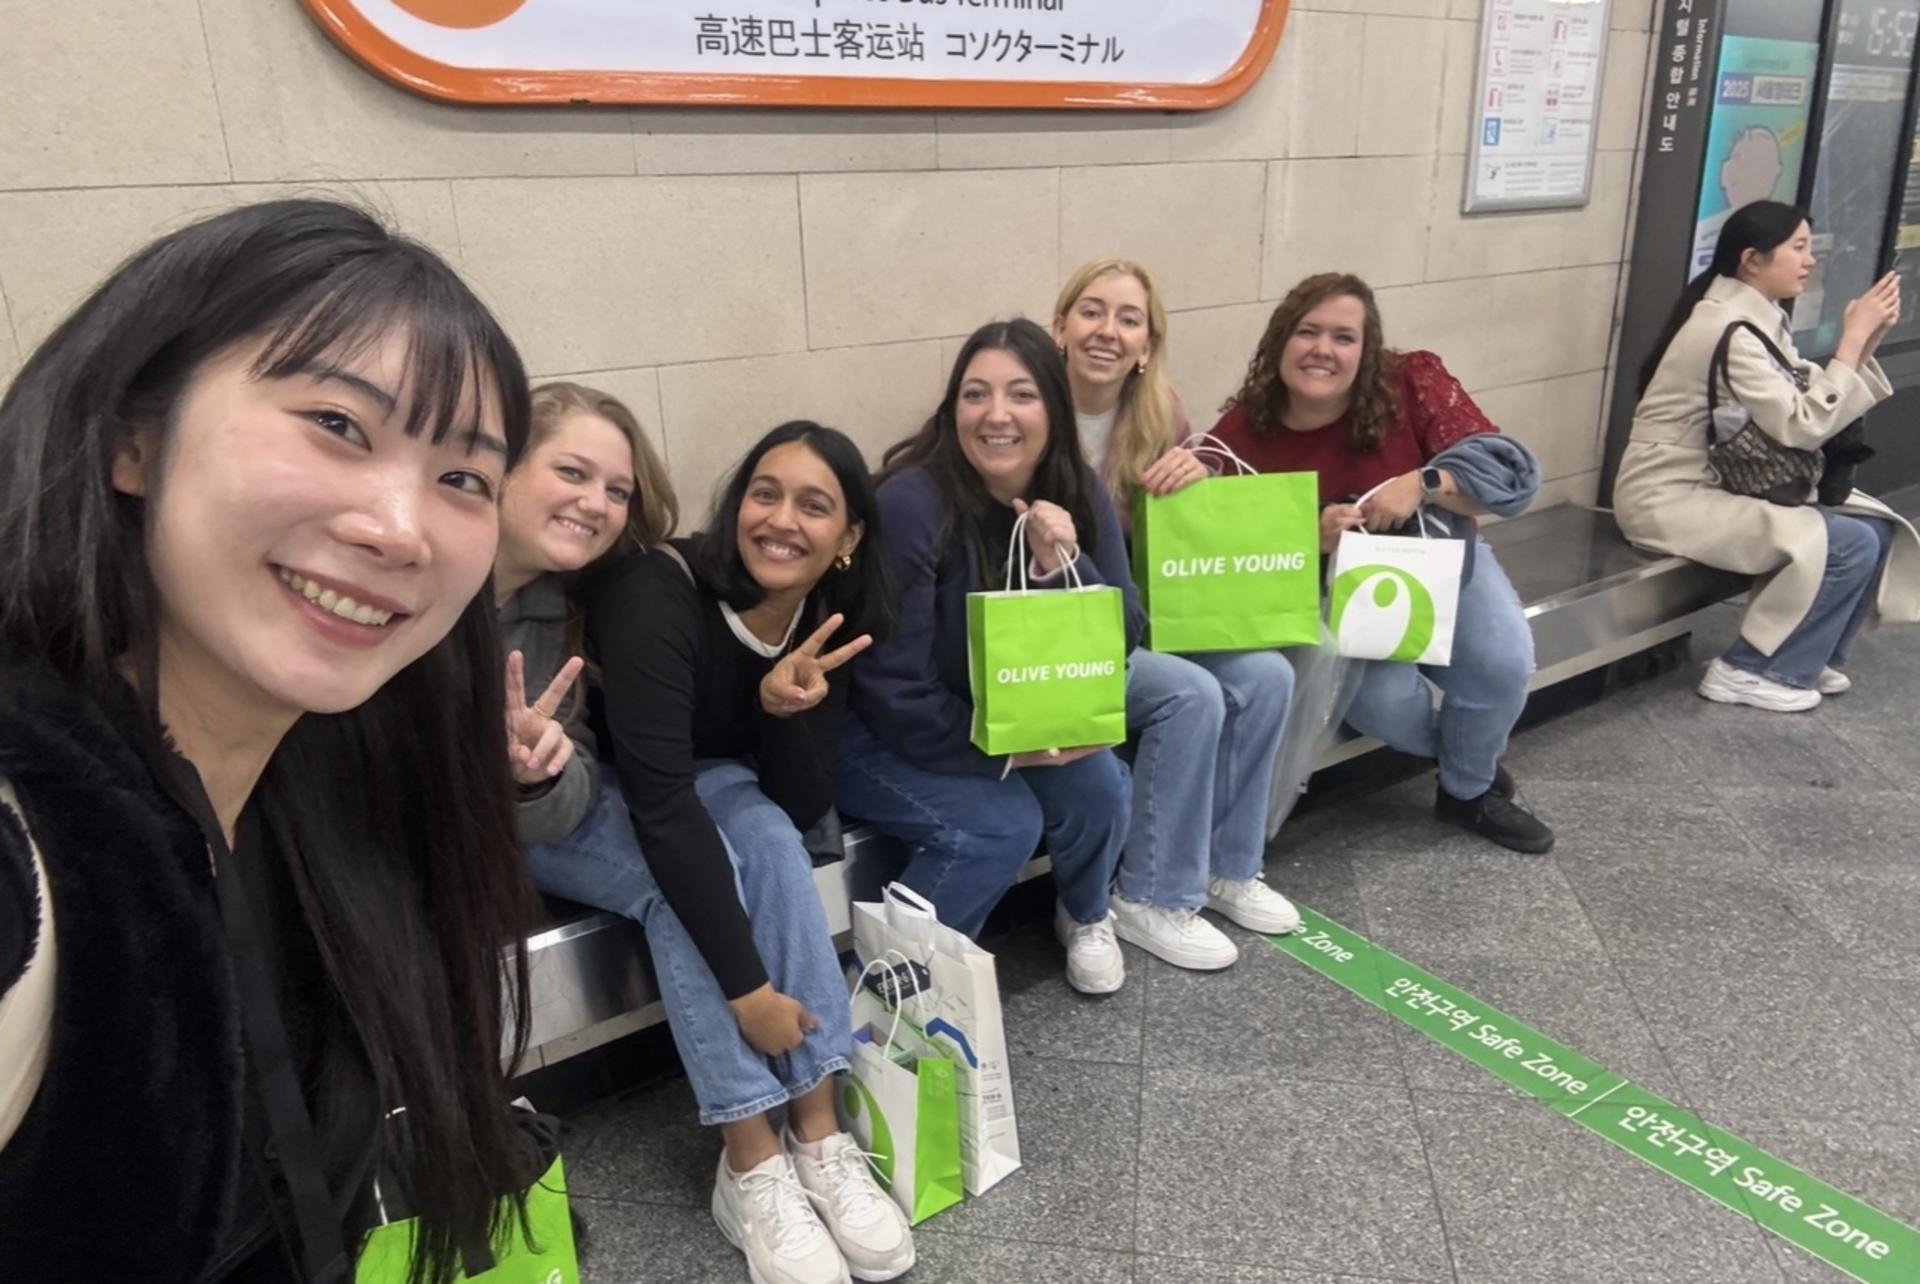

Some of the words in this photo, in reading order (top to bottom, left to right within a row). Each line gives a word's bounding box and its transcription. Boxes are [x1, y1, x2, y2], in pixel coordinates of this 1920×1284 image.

[694, 13, 925, 61] 高速巴士客运站
[946, 29, 1125, 64] コソクターミナル
[1690, 18, 1709, 80] Information
[1162, 556, 1226, 577] OLIVE
[1232, 552, 1306, 573] YOUNG
[997, 664, 1051, 684] OLIVE
[1055, 660, 1116, 679] YOUNG
[1302, 931, 1354, 963] Zone
[1385, 978, 1480, 1031] 안전구역
[1468, 1024, 1524, 1059] Safe
[1520, 1052, 1588, 1094] Zone
[1619, 1106, 1739, 1176] 안전구역
[1733, 1166, 1802, 1213] Safe
[1803, 1204, 1890, 1260] Zone
